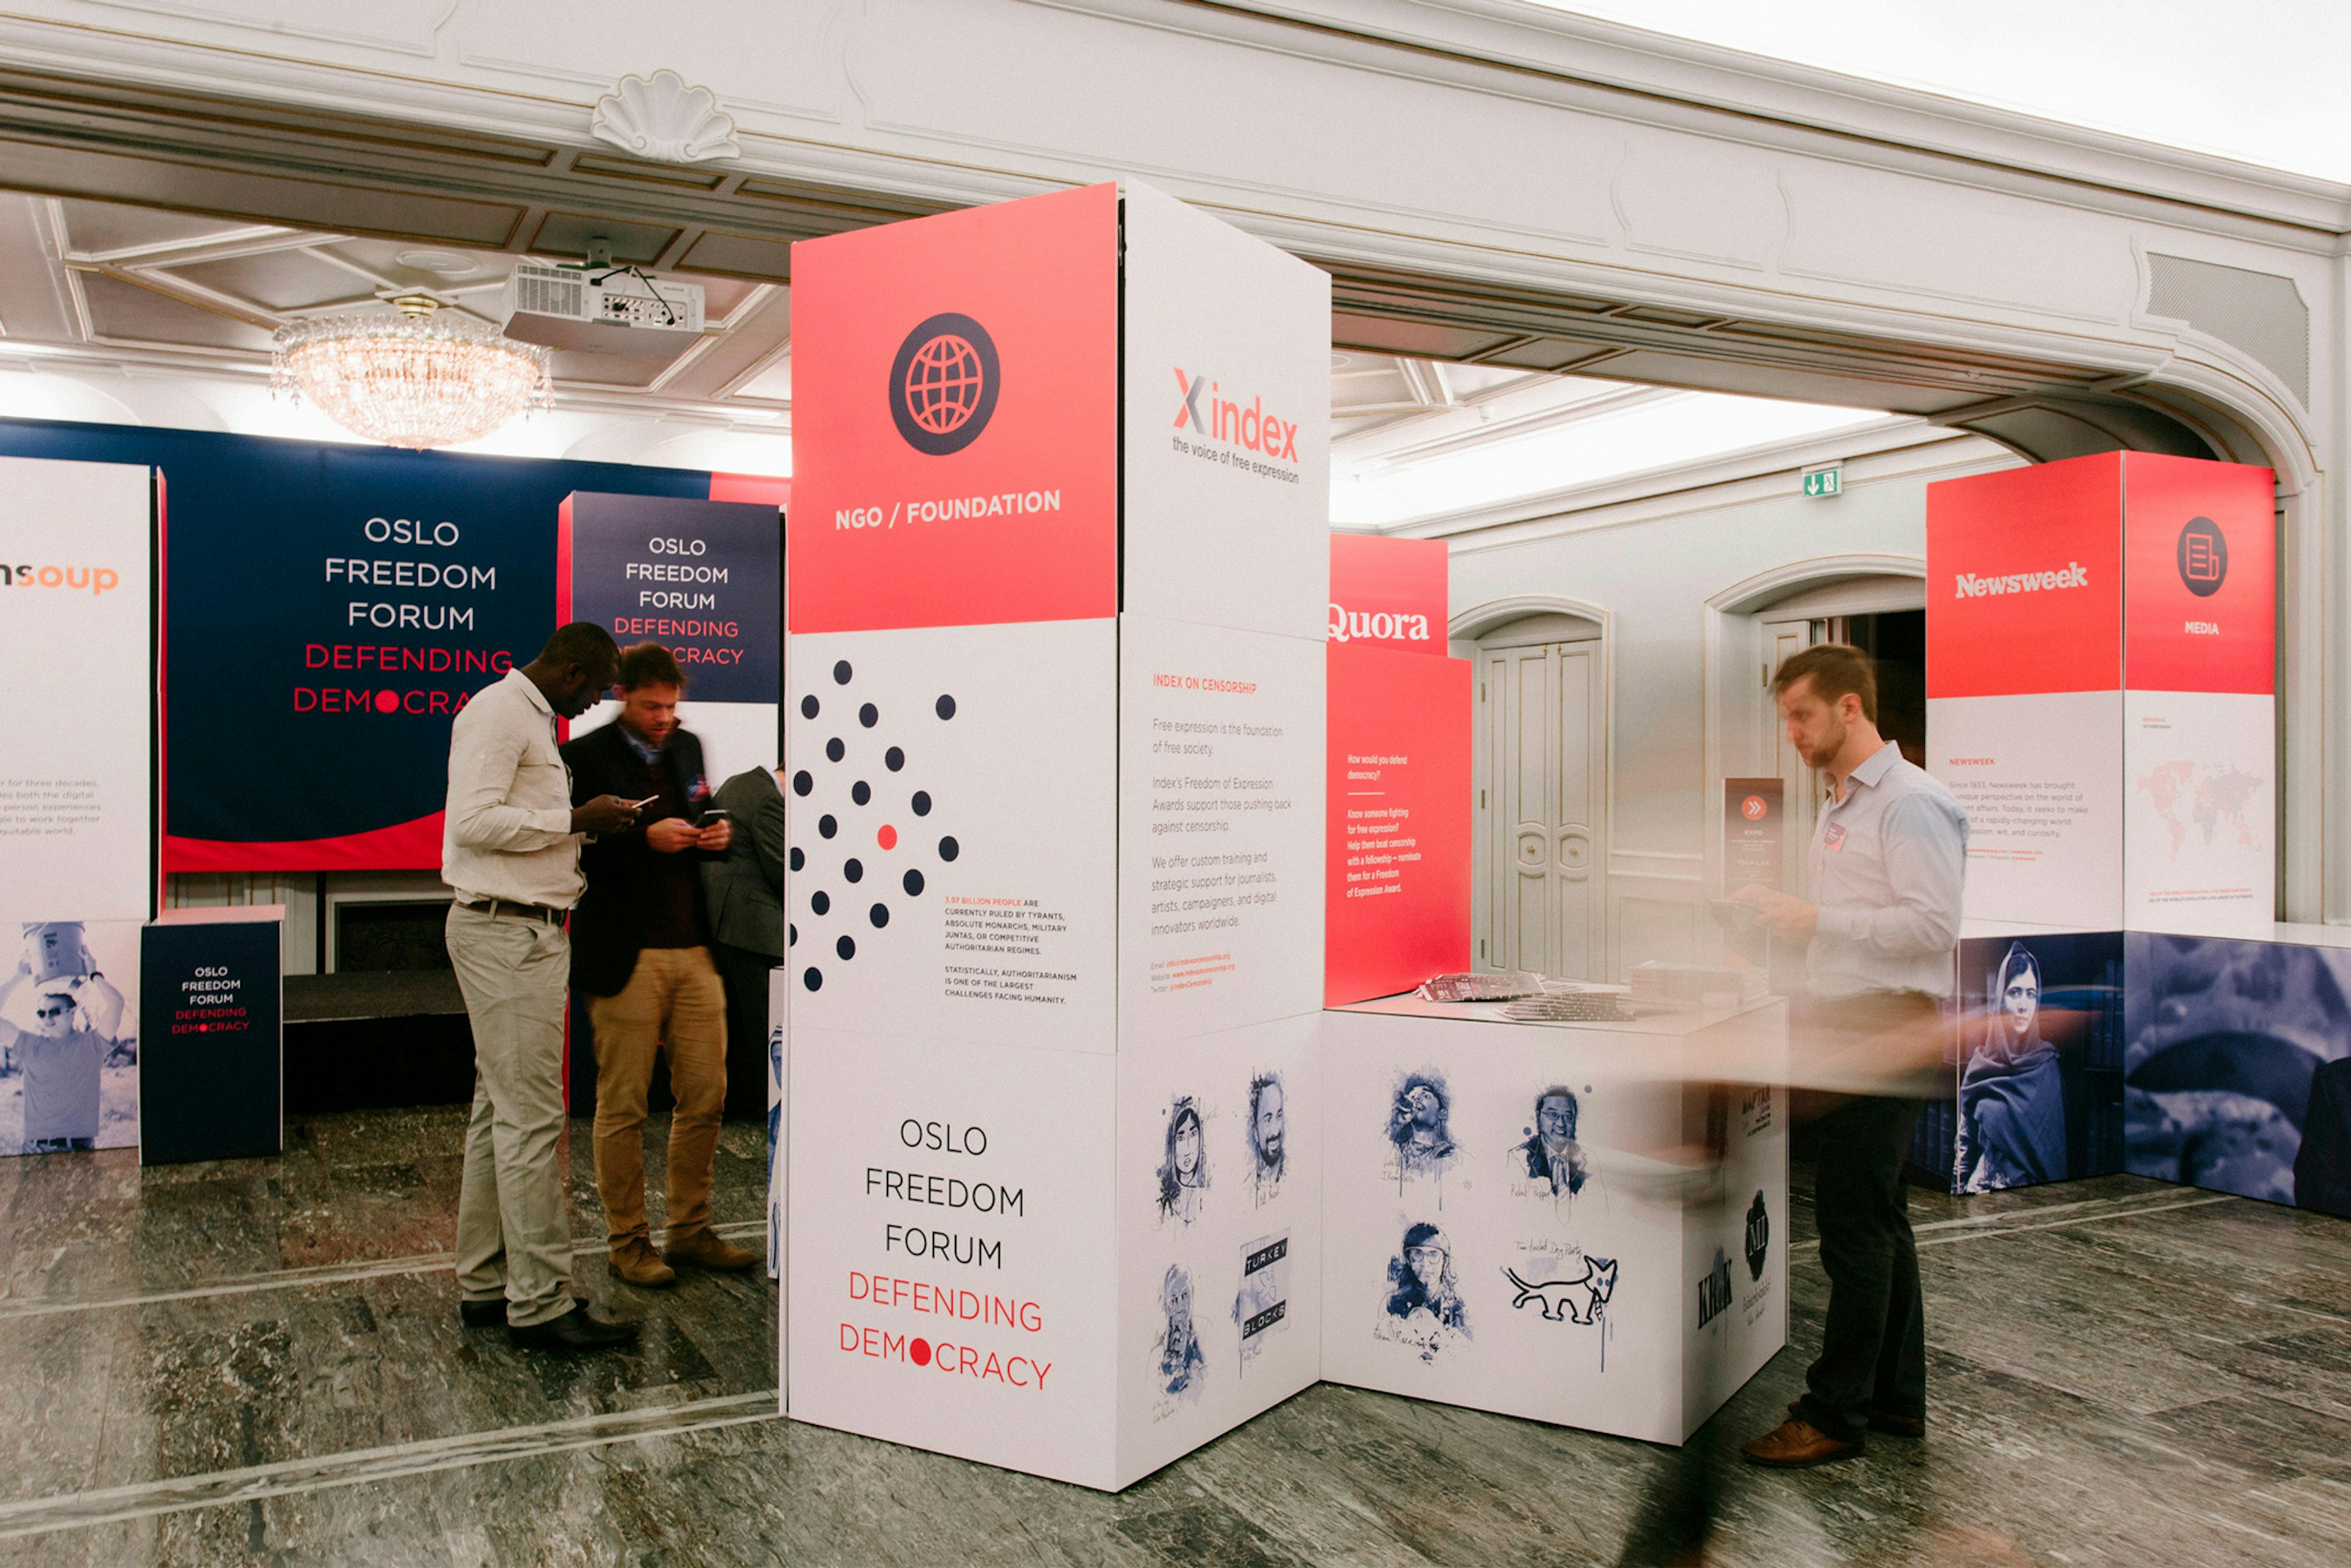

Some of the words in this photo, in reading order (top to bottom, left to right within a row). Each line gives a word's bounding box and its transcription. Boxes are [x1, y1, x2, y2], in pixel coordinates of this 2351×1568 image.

[1173, 436, 1188, 453] the
[1192, 444, 1217, 461] voice
[1220, 451, 1230, 464] of
[1233, 453, 1250, 470] free
[1252, 462, 1299, 483] expression
[836, 506, 882, 530] NGO
[888, 502, 901, 528] /
[907, 489, 1060, 524] FOUNDATION
[364, 517, 459, 546] OSLO
[649, 537, 706, 556] OSLO
[326, 557, 496, 590] FREEDOM
[626, 563, 728, 583] FREEDOM
[1956, 562, 2087, 598] Newsweek
[640, 591, 714, 610] FORUM
[349, 602, 473, 630] FORUM
[1328, 604, 1430, 642] Quora
[615, 617, 738, 637] DEFENDING
[2185, 621, 2219, 635] MEDIA
[306, 644, 513, 674] DEFENDING
[1153, 674, 1182, 688] INDEX
[1185, 677, 1199, 689] ON
[1202, 678, 1257, 694] CENSORSHIP
[1153, 718, 1172, 732] Free
[1175, 721, 1217, 734] expression
[1220, 723, 1226, 734] is
[1229, 723, 1241, 735] the
[1243, 724, 1283, 737] foundation
[1153, 741, 1162, 753] of
[1164, 741, 1181, 753] free
[1184, 742, 1213, 756] society.
[1348, 755, 1360, 764] How
[1362, 755, 1377, 763] would
[1379, 756, 1388, 766] you
[1389, 755, 1407, 764] defend
[1348, 770, 1380, 780] democracy?
[1184, 777, 1220, 789] Freedom
[1223, 777, 1231, 789] of
[1233, 777, 1273, 790] Expression
[1152, 799, 1184, 811] Awards
[1187, 799, 1217, 812] support
[1221, 799, 1241, 809] those
[1244, 798, 1272, 811] pushing
[1275, 798, 1291, 809] back
[1348, 810, 1362, 819] Know
[1364, 809, 1388, 818] someone
[1389, 808, 1409, 819] fighting
[1152, 821, 1182, 835] against
[1357, 825, 1367, 833] free
[1369, 823, 1399, 834] expression?
[1987, 817, 2047, 826] rapidly-changing
[1348, 841, 1360, 851] Help
[1362, 840, 1374, 849] them
[1389, 837, 1416, 847] censorship
[1152, 857, 1166, 868] We
[1169, 855, 1188, 868] offer
[1191, 855, 1220, 867] custom
[1223, 853, 1251, 865] training
[1254, 851, 1268, 862] and
[1348, 857, 1359, 866] with
[1366, 854, 1391, 865] fellowship
[1152, 878, 1188, 891] strategic
[1191, 875, 1222, 889] support
[1224, 874, 1236, 886] for
[1348, 873, 1361, 882] them
[1376, 869, 1399, 879] Freedom
[1348, 888, 1353, 898] of
[1355, 886, 1382, 897] Expression
[1152, 901, 1180, 913] artists,
[1182, 897, 1235, 910] campaigners,
[1237, 893, 1251, 905] and
[1254, 892, 1276, 905] digital
[945, 908, 986, 917] CURRENTLY
[1029, 912, 1065, 921] TYRANTS,
[985, 922, 1030, 931] MONARCHS,
[1152, 921, 1195, 935] innovators
[1198, 915, 1240, 930] worldwide.
[989, 934, 1039, 942] COMPETITIVE
[945, 943, 1004, 952] AUTHORITARIAN
[195, 966, 227, 977] OSLO
[945, 966, 999, 977] STATISTICALLY,
[1001, 970, 1077, 980] AUTHORITARIANISM
[182, 980, 240, 991] FREEDOM
[1000, 981, 1033, 990] LARGEST
[190, 994, 233, 1005] FORUM
[945, 990, 992, 999] CHALLENGES
[1024, 995, 1066, 1004] HUMANITY.
[176, 1007, 247, 1020] DEFENDING
[901, 1119, 987, 1155] OSLO
[867, 1167, 1023, 1217] FREEDOM
[887, 1224, 1001, 1269] FORUM
[1247, 1244, 1287, 1271] TURKEY
[850, 1271, 1041, 1332] DEFENDING
[1244, 1305, 1285, 1336] BLOCKS
